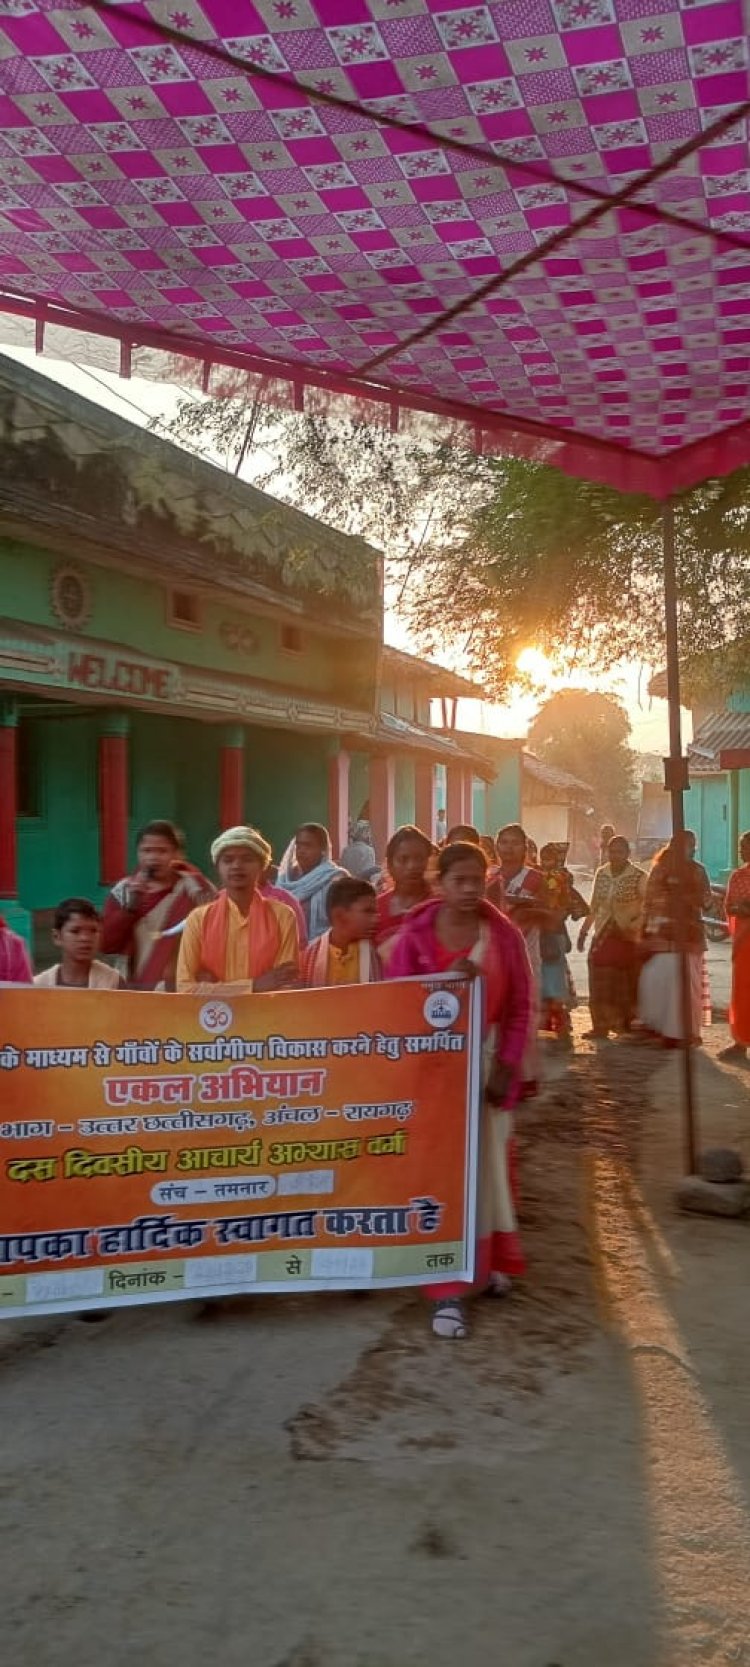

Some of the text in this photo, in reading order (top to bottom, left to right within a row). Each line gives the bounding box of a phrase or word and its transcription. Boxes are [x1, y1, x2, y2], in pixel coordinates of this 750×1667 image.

[68, 652, 169, 699] WELCOME
[0, 1045, 19, 1068] के
[25, 1047, 88, 1067] माध्यम
[93, 1041, 110, 1065] से
[164, 1038, 182, 1061] के
[268, 1035, 327, 1058] विकास
[332, 1032, 371, 1055] करने
[375, 1033, 400, 1060] हेतु
[405, 1030, 464, 1052] समर्पित
[105, 1068, 323, 1103] एकल अभियान
[1, 1121, 51, 1137] भाग
[80, 1117, 137, 1134] उत्तर
[264, 1105, 320, 1124] अंचल
[8, 1158, 55, 1182] दस
[65, 1148, 167, 1178] दिवसीय
[178, 1139, 261, 1170] आचार्य
[269, 1140, 360, 1165] अभ्यास
[159, 1183, 187, 1201] संच
[214, 1181, 269, 1198] तमनार
[98, 1216, 207, 1253] हार्दिक
[214, 1211, 317, 1243] स्वागत
[322, 1207, 411, 1235] करता
[412, 1199, 441, 1230] है
[108, 1269, 166, 1290] दिनांक
[285, 1255, 302, 1274] से
[425, 1253, 455, 1268] तक
